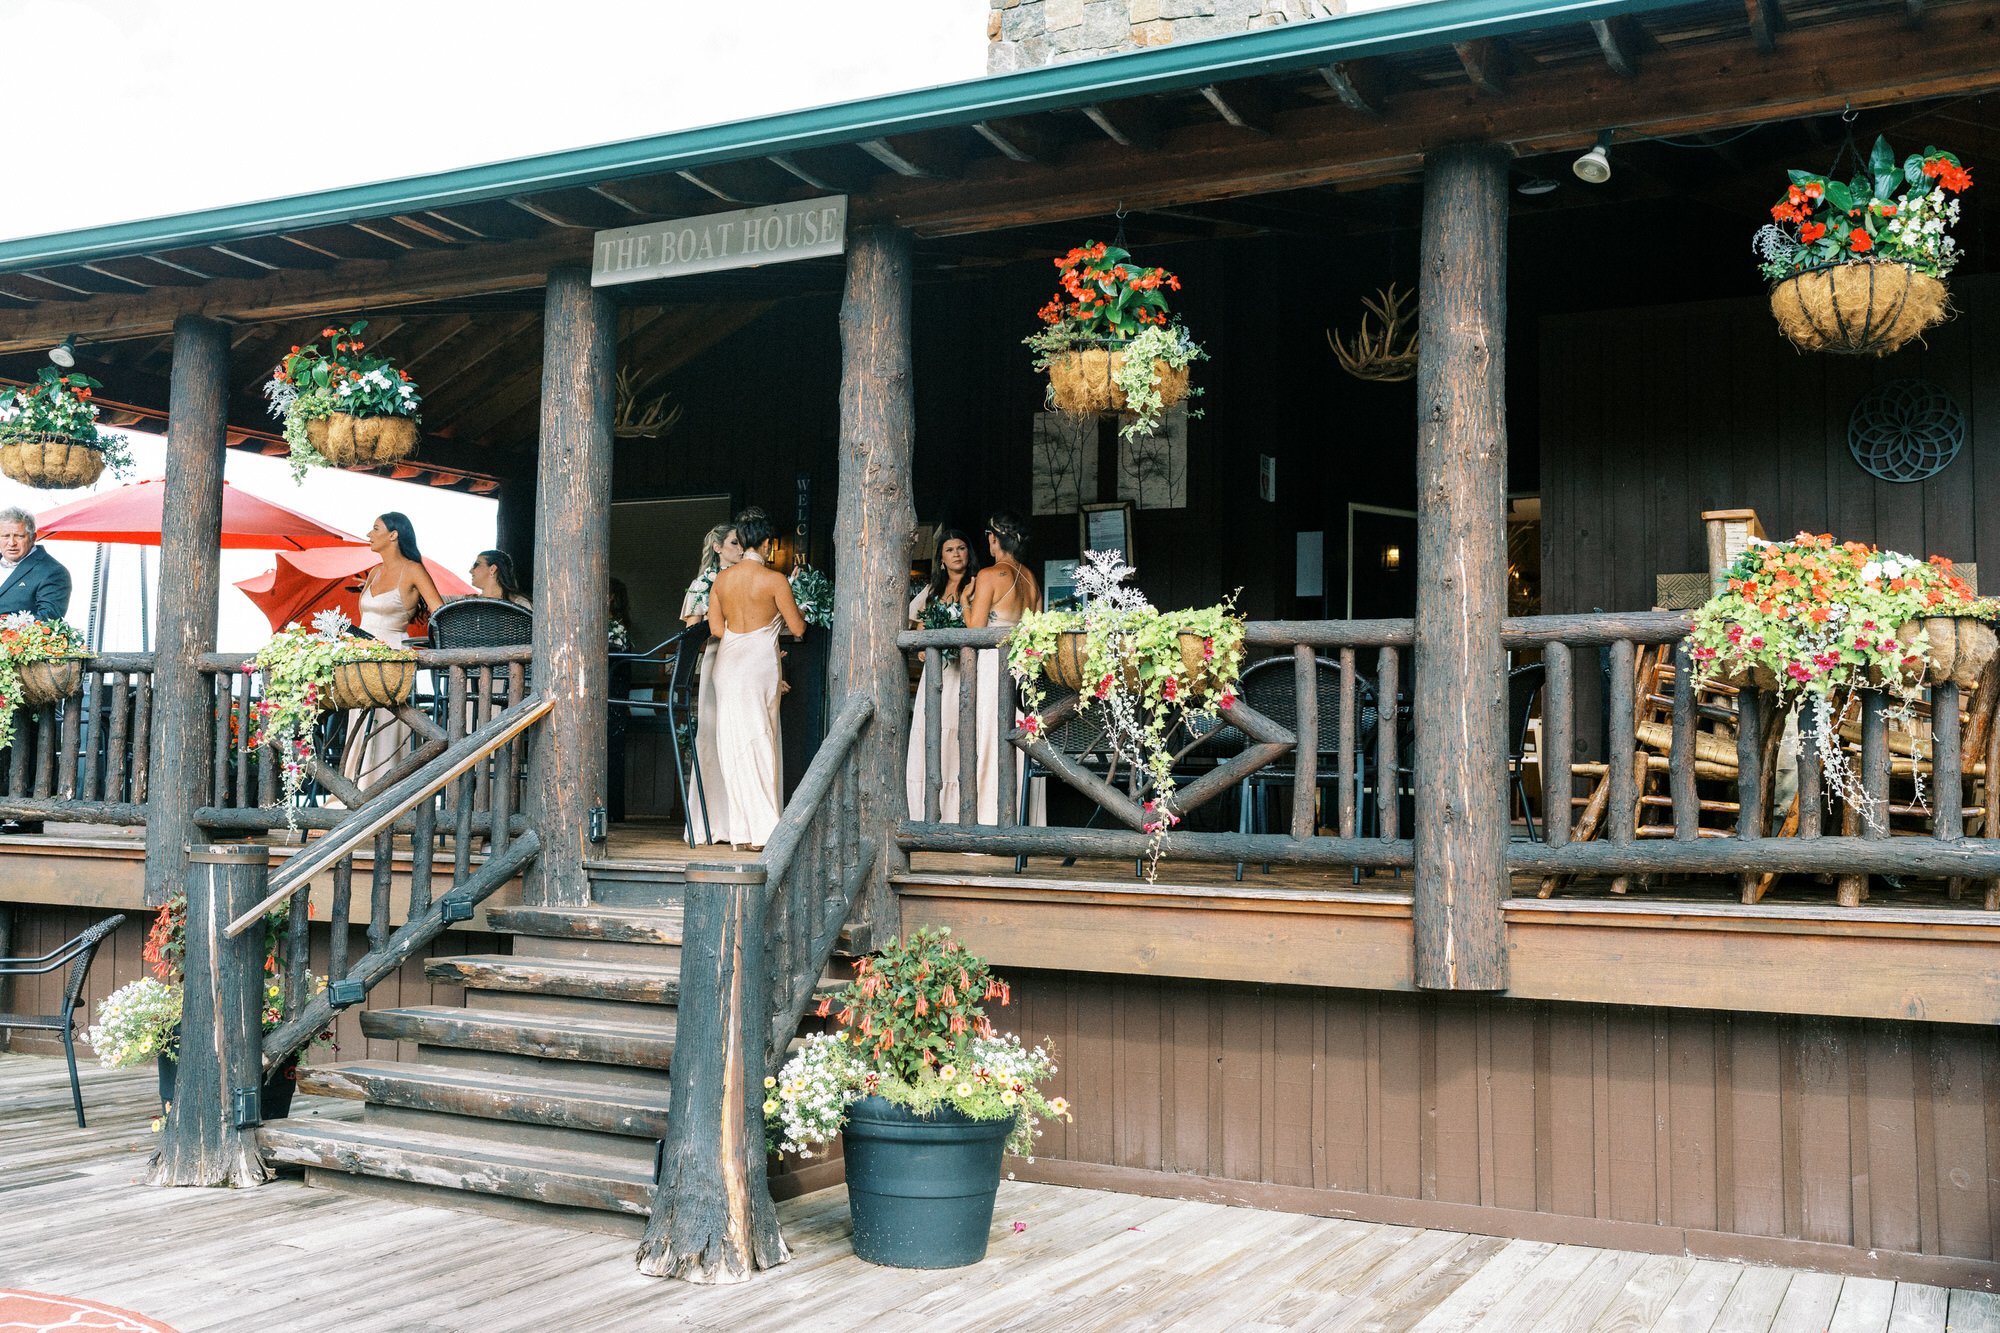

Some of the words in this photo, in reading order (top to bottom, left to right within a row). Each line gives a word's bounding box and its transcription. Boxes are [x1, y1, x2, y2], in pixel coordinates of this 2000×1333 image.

[600, 235, 651, 273] THE
[659, 223, 734, 265] BOAT
[740, 207, 838, 254] HOUSE
